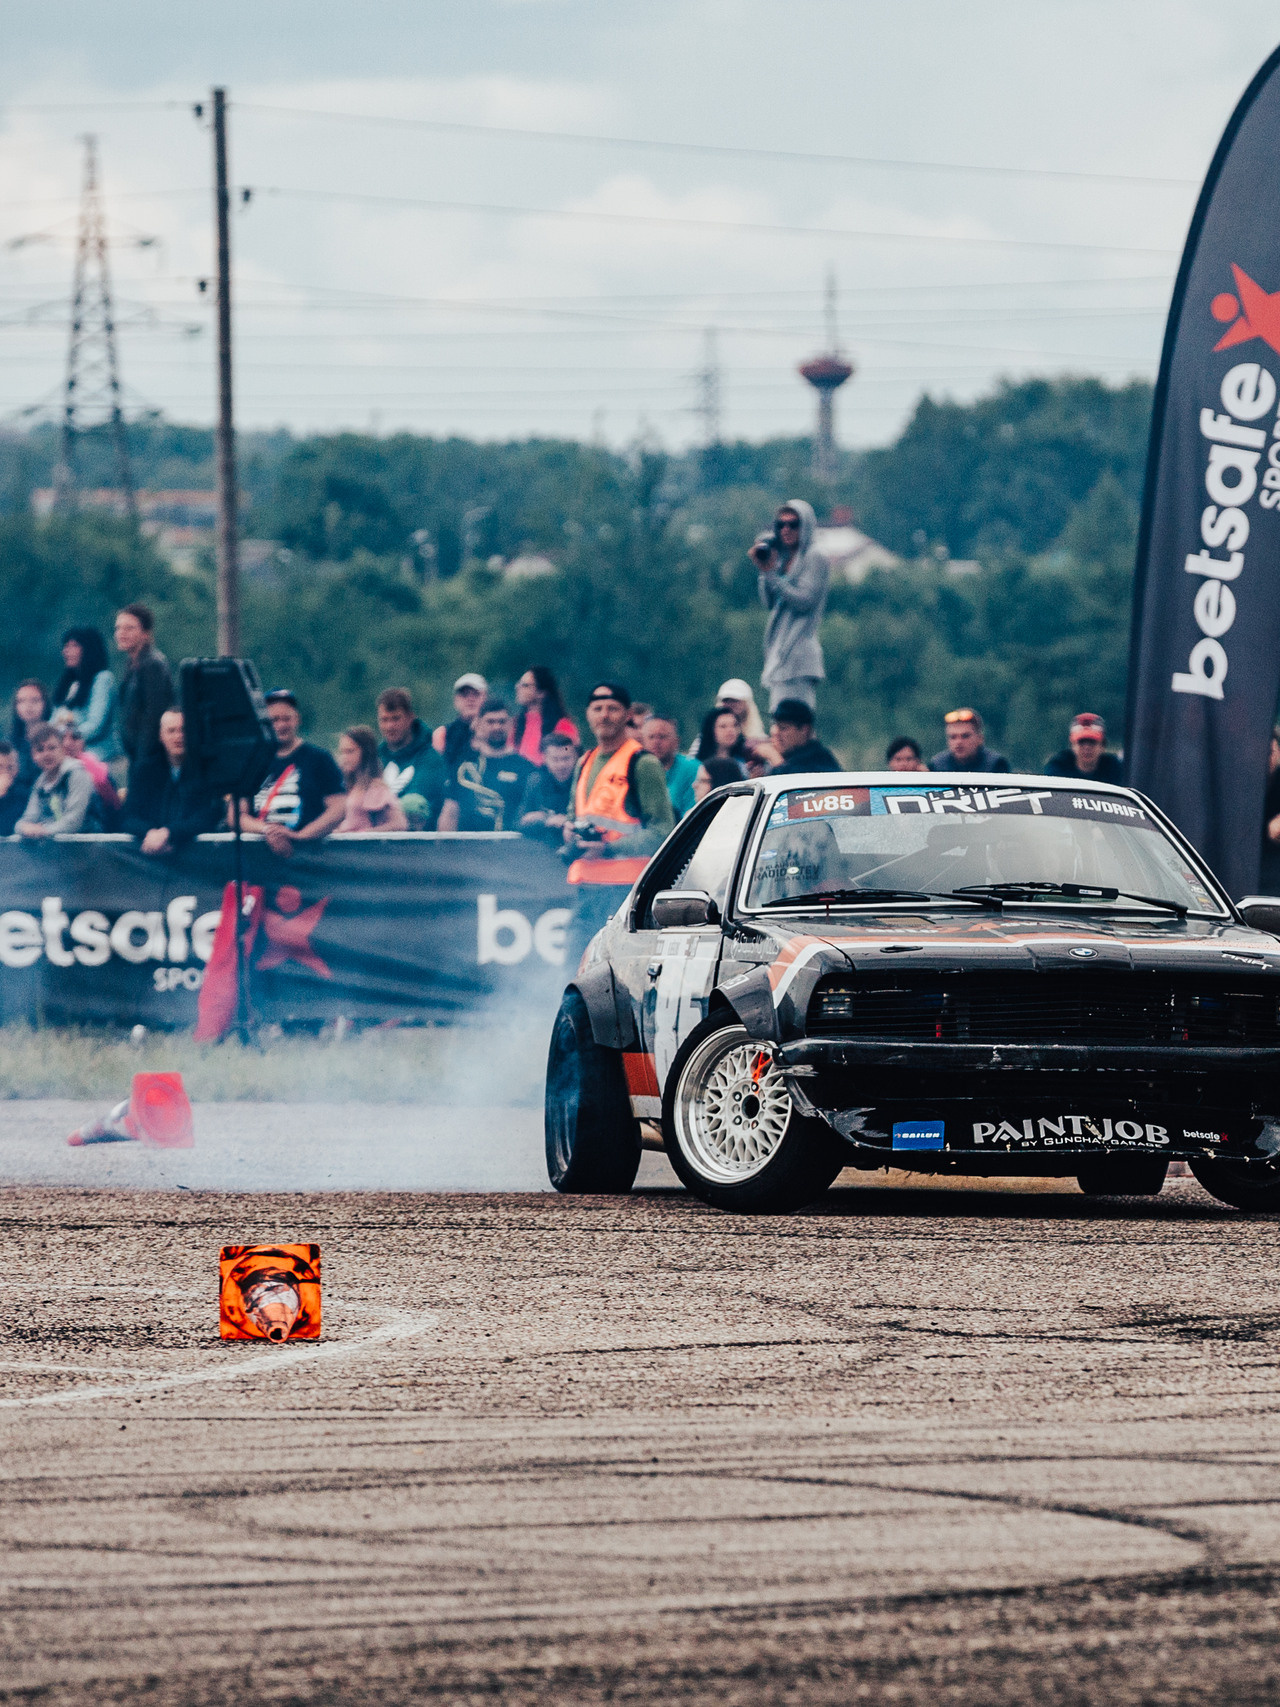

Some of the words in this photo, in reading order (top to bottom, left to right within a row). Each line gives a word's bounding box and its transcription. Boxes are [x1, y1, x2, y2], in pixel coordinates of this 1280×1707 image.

[1171, 362, 1277, 700] betsafe
[803, 794, 855, 813] LV85
[1071, 797, 1146, 820] #LVDRIFT
[0, 896, 223, 968] etsafe
[1043, 1136, 1106, 1146] GUNCHA
[1183, 1129, 1221, 1140] betsafe
